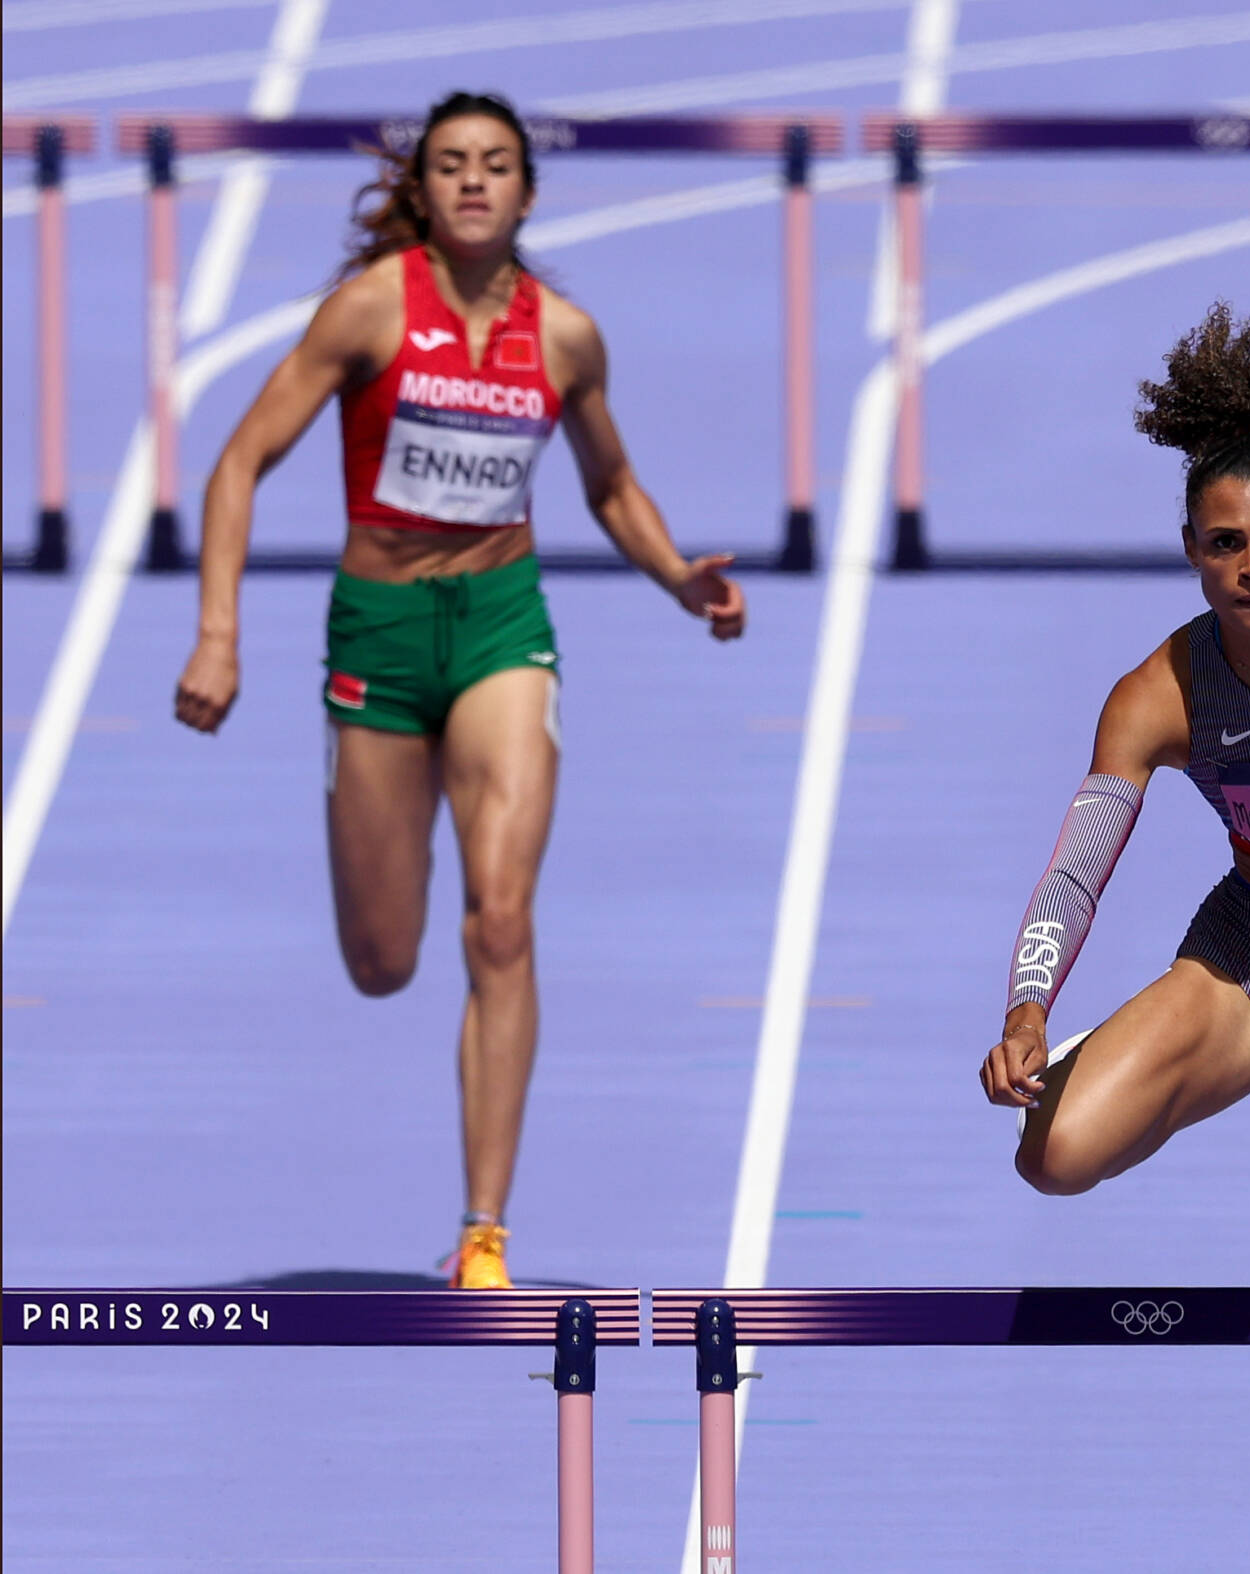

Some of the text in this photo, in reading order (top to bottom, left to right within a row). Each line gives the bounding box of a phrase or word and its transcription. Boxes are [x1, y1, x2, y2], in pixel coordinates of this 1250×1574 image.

[399, 369, 546, 420] MOROCCO
[401, 440, 533, 490] ENNADI
[1015, 920, 1065, 991] USA
[161, 1302, 269, 1330] 2024
